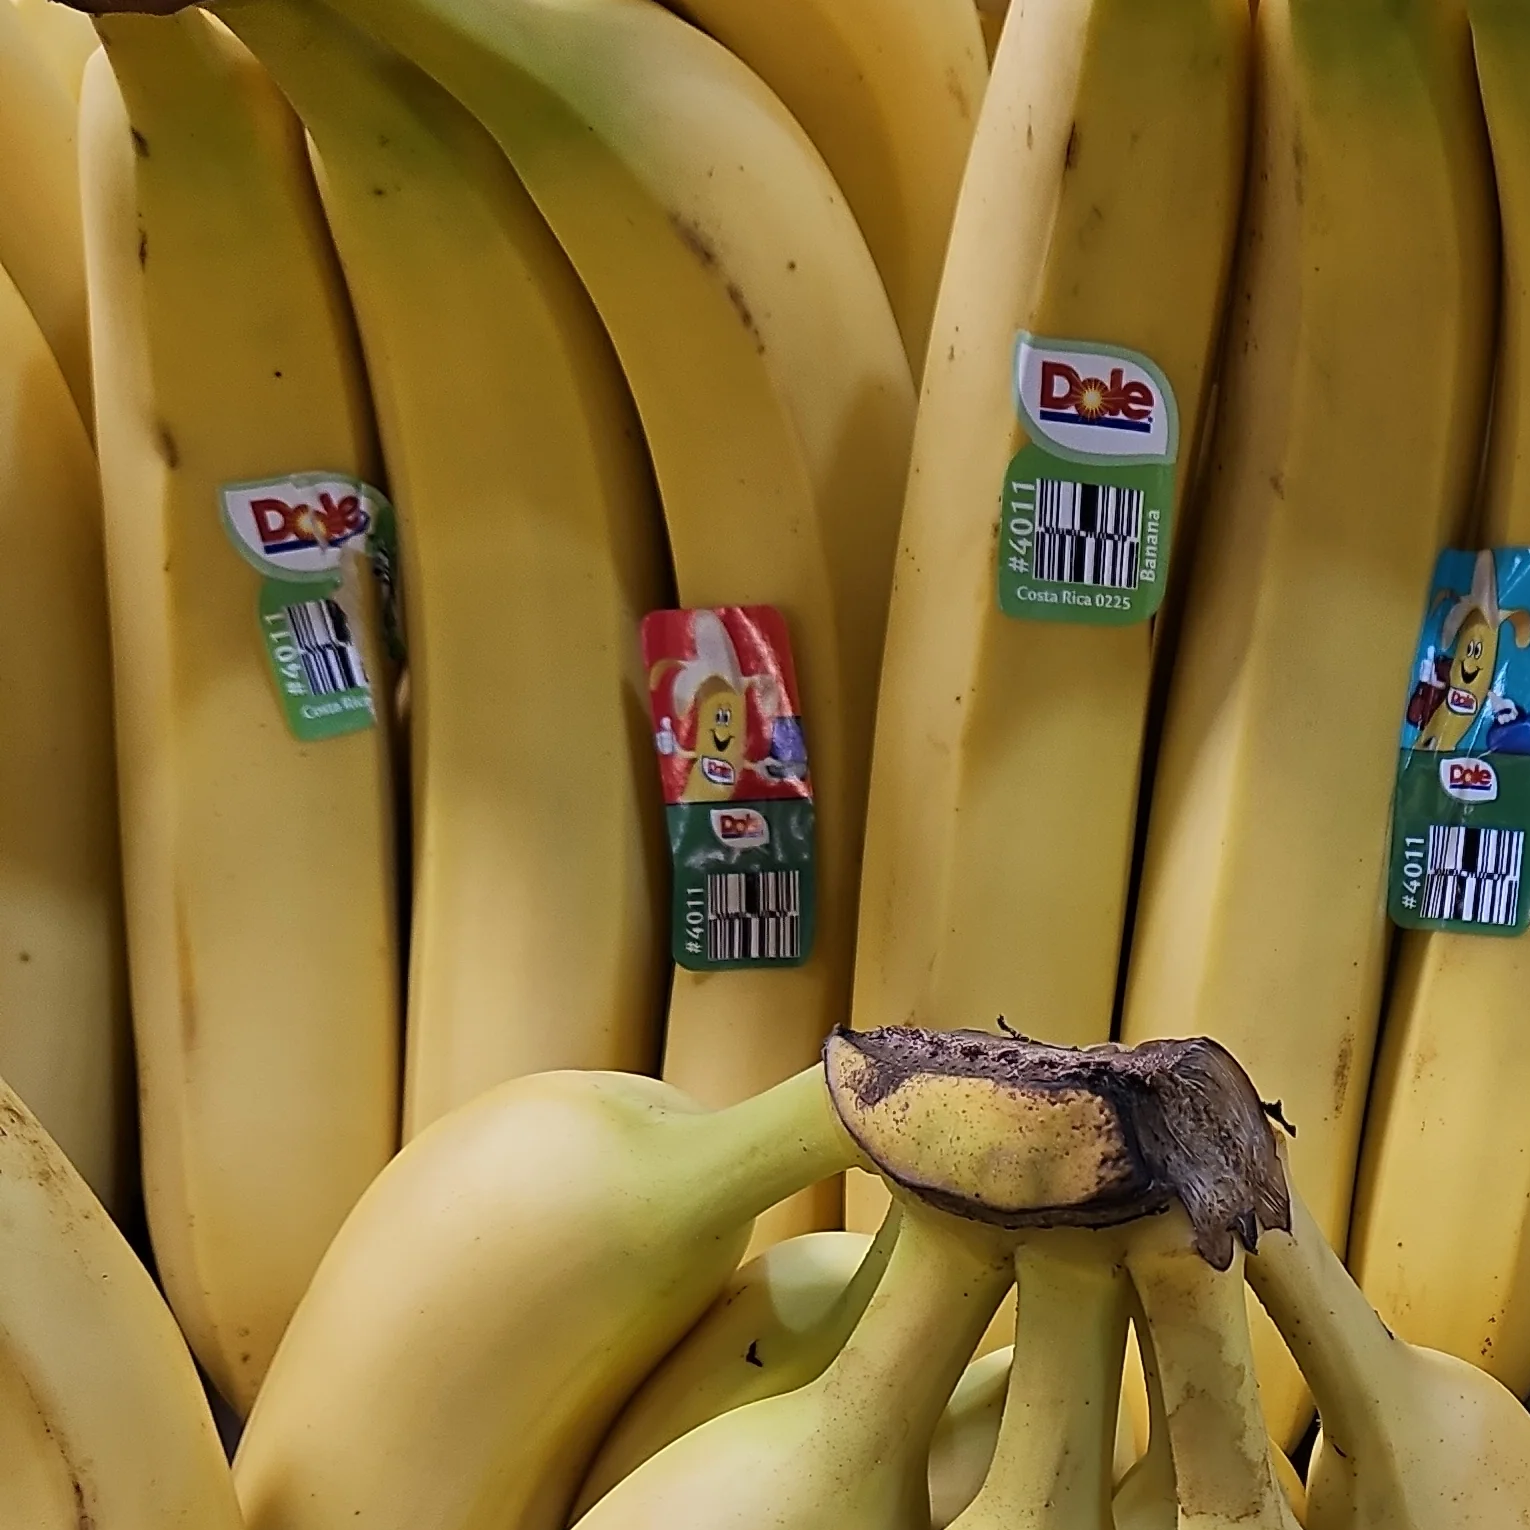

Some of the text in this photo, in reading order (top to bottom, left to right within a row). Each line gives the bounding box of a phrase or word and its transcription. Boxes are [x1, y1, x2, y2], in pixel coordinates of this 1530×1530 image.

[1040, 360, 1154, 421] Dole
[250, 492, 364, 542] Dole
[1008, 480, 1035, 573] #4011
[1140, 509, 1161, 582] Banana
[1017, 586, 1131, 610] Costa Rica 0225
[264, 612, 308, 697] #4011
[1450, 764, 1492, 786] Dole
[1402, 837, 1425, 909] #4011
[685, 888, 705, 954] #4011
